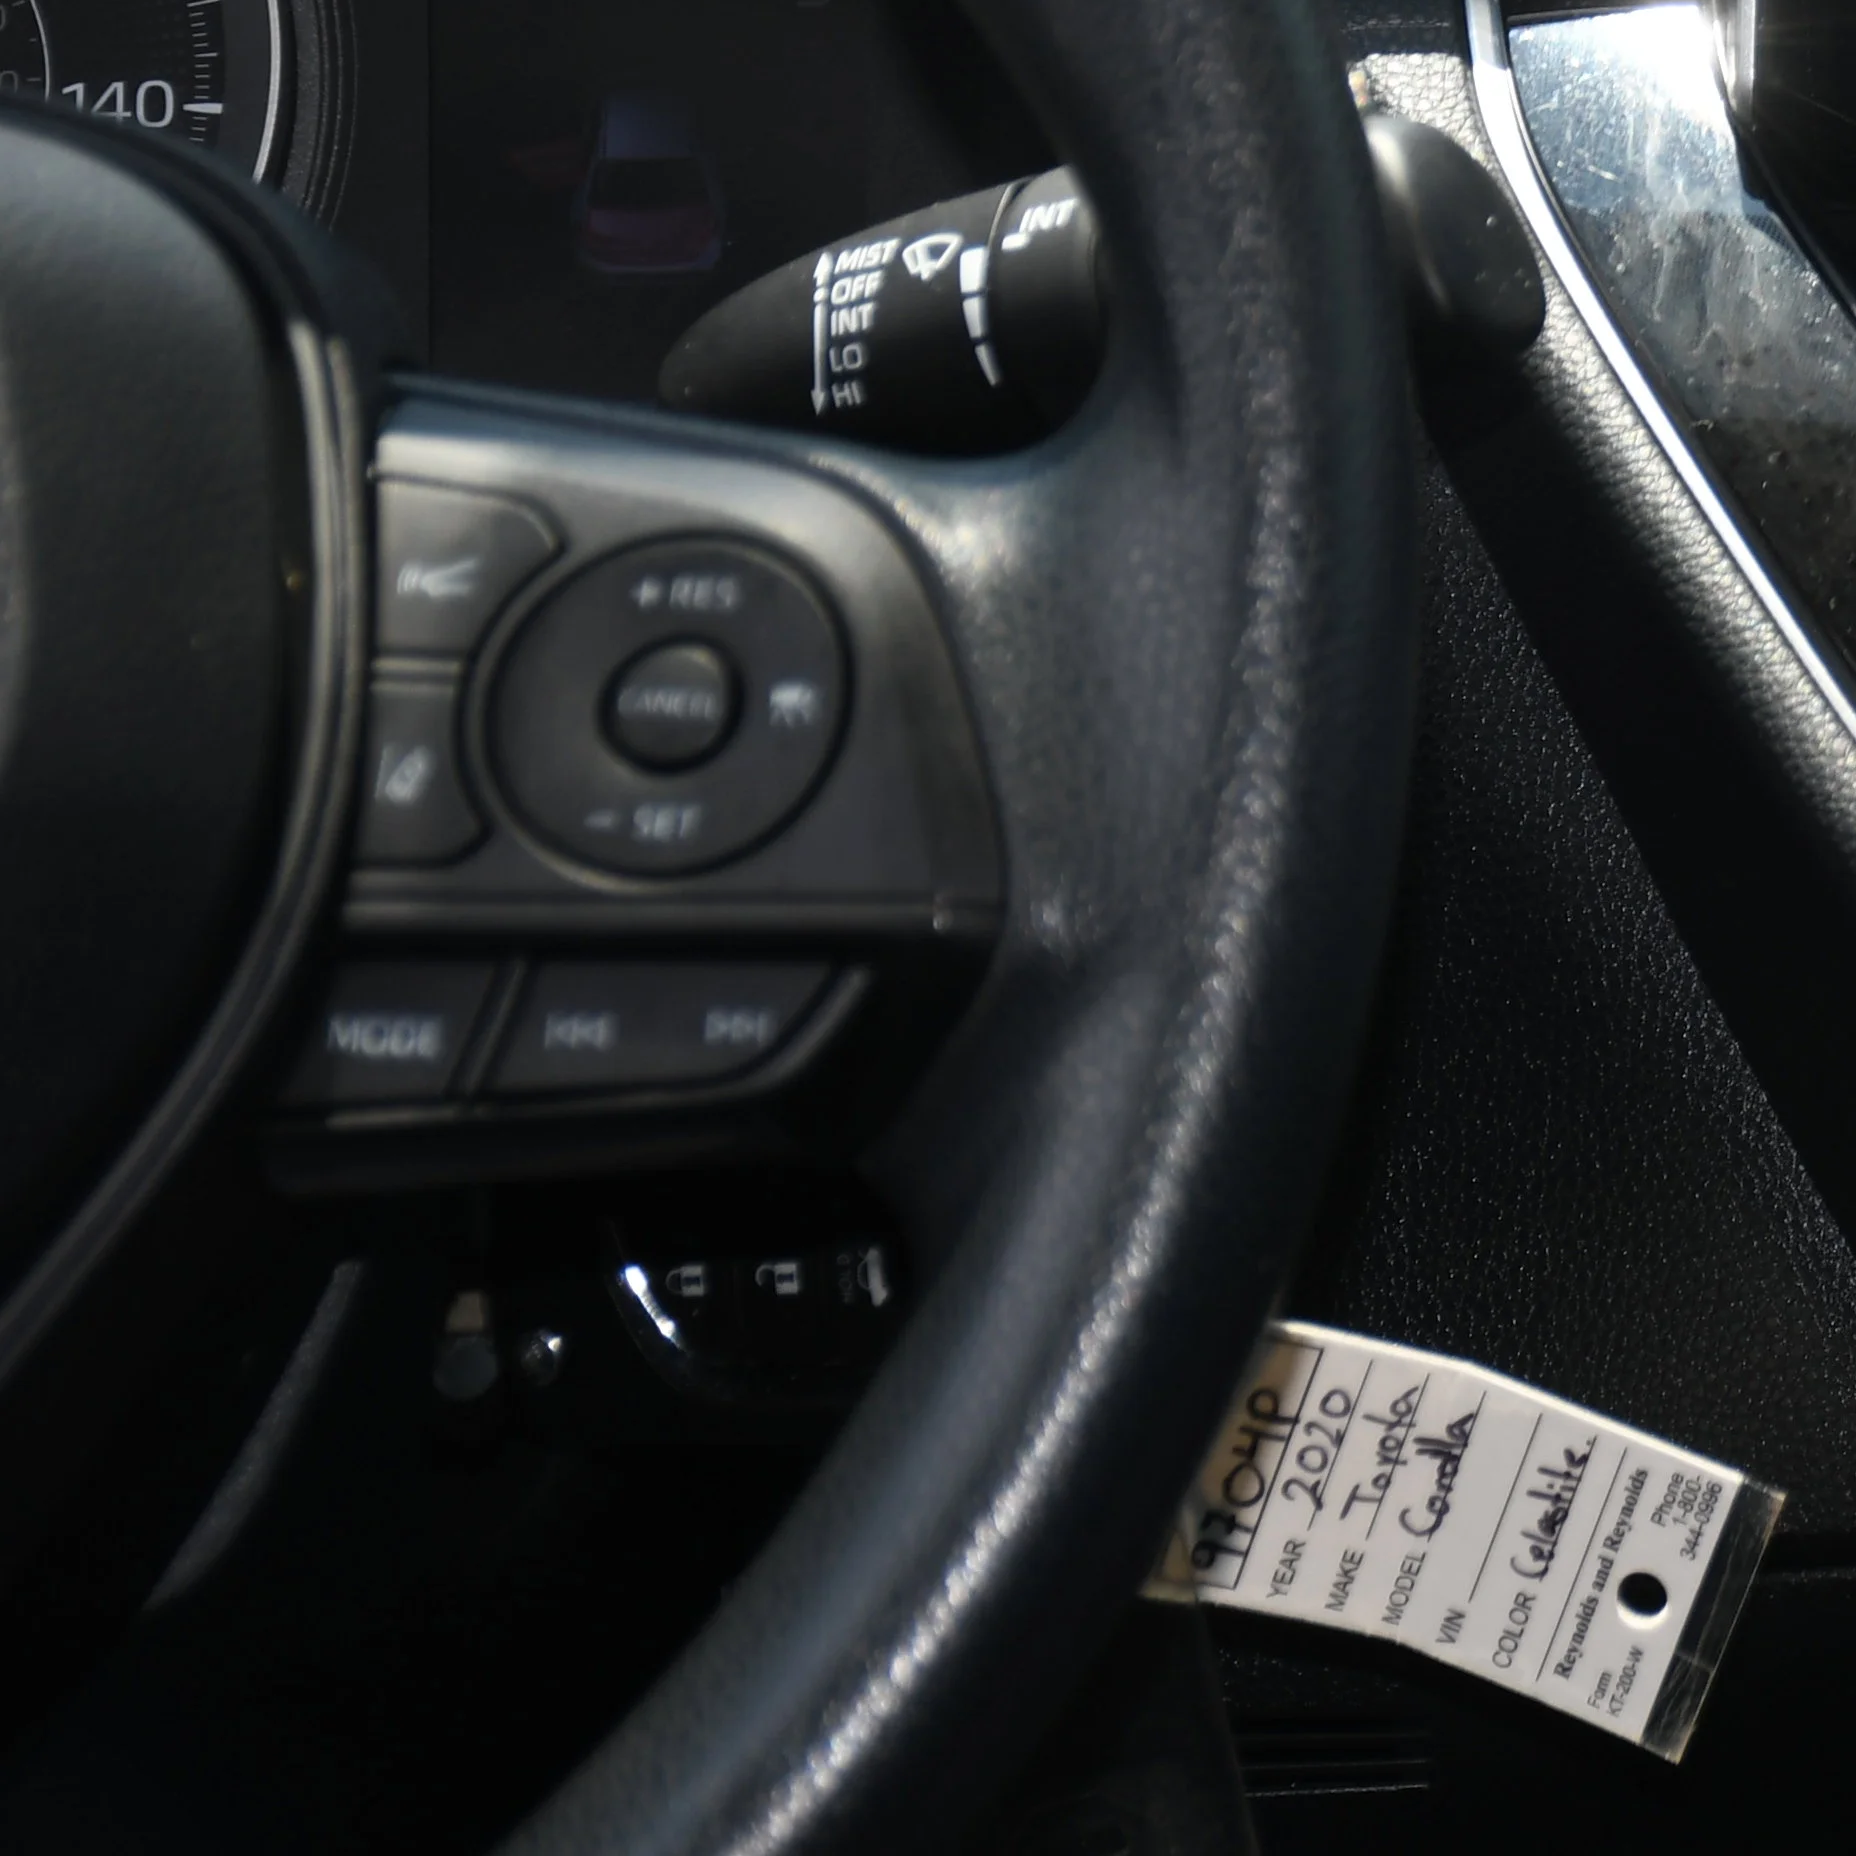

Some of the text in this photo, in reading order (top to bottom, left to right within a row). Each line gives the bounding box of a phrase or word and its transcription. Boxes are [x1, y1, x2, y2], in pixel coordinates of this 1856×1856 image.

[61, 79, 175, 129] 140
[1018, 197, 1077, 233] INT
[833, 237, 901, 275] MIST
[830, 269, 883, 307] OFF
[830, 302, 876, 337] INT
[829, 344, 863, 374] LO
[831, 381, 862, 410] HI
[669, 575, 741, 611] RES
[617, 687, 720, 722] CANCEL
[632, 805, 700, 840] SET
[327, 1013, 444, 1061] MODE
[1266, 1388, 1352, 1599] YEAR 2020
[1324, 1385, 1420, 1612] MAKE Toyota
[1650, 1471, 1685, 1528] Phone
[1672, 1475, 1703, 1527] 1-800-
[1679, 1481, 1723, 1562] 344-0996
[1381, 1550, 1428, 1626] MODEL
[1553, 1467, 1649, 1681] Reynolds and Reynolds
[1436, 1607, 1467, 1646] VIN
[1492, 1591, 1537, 1669] COLOR
[1587, 1670, 1613, 1710] Form
[1606, 1644, 1645, 1719] KT-200-W
